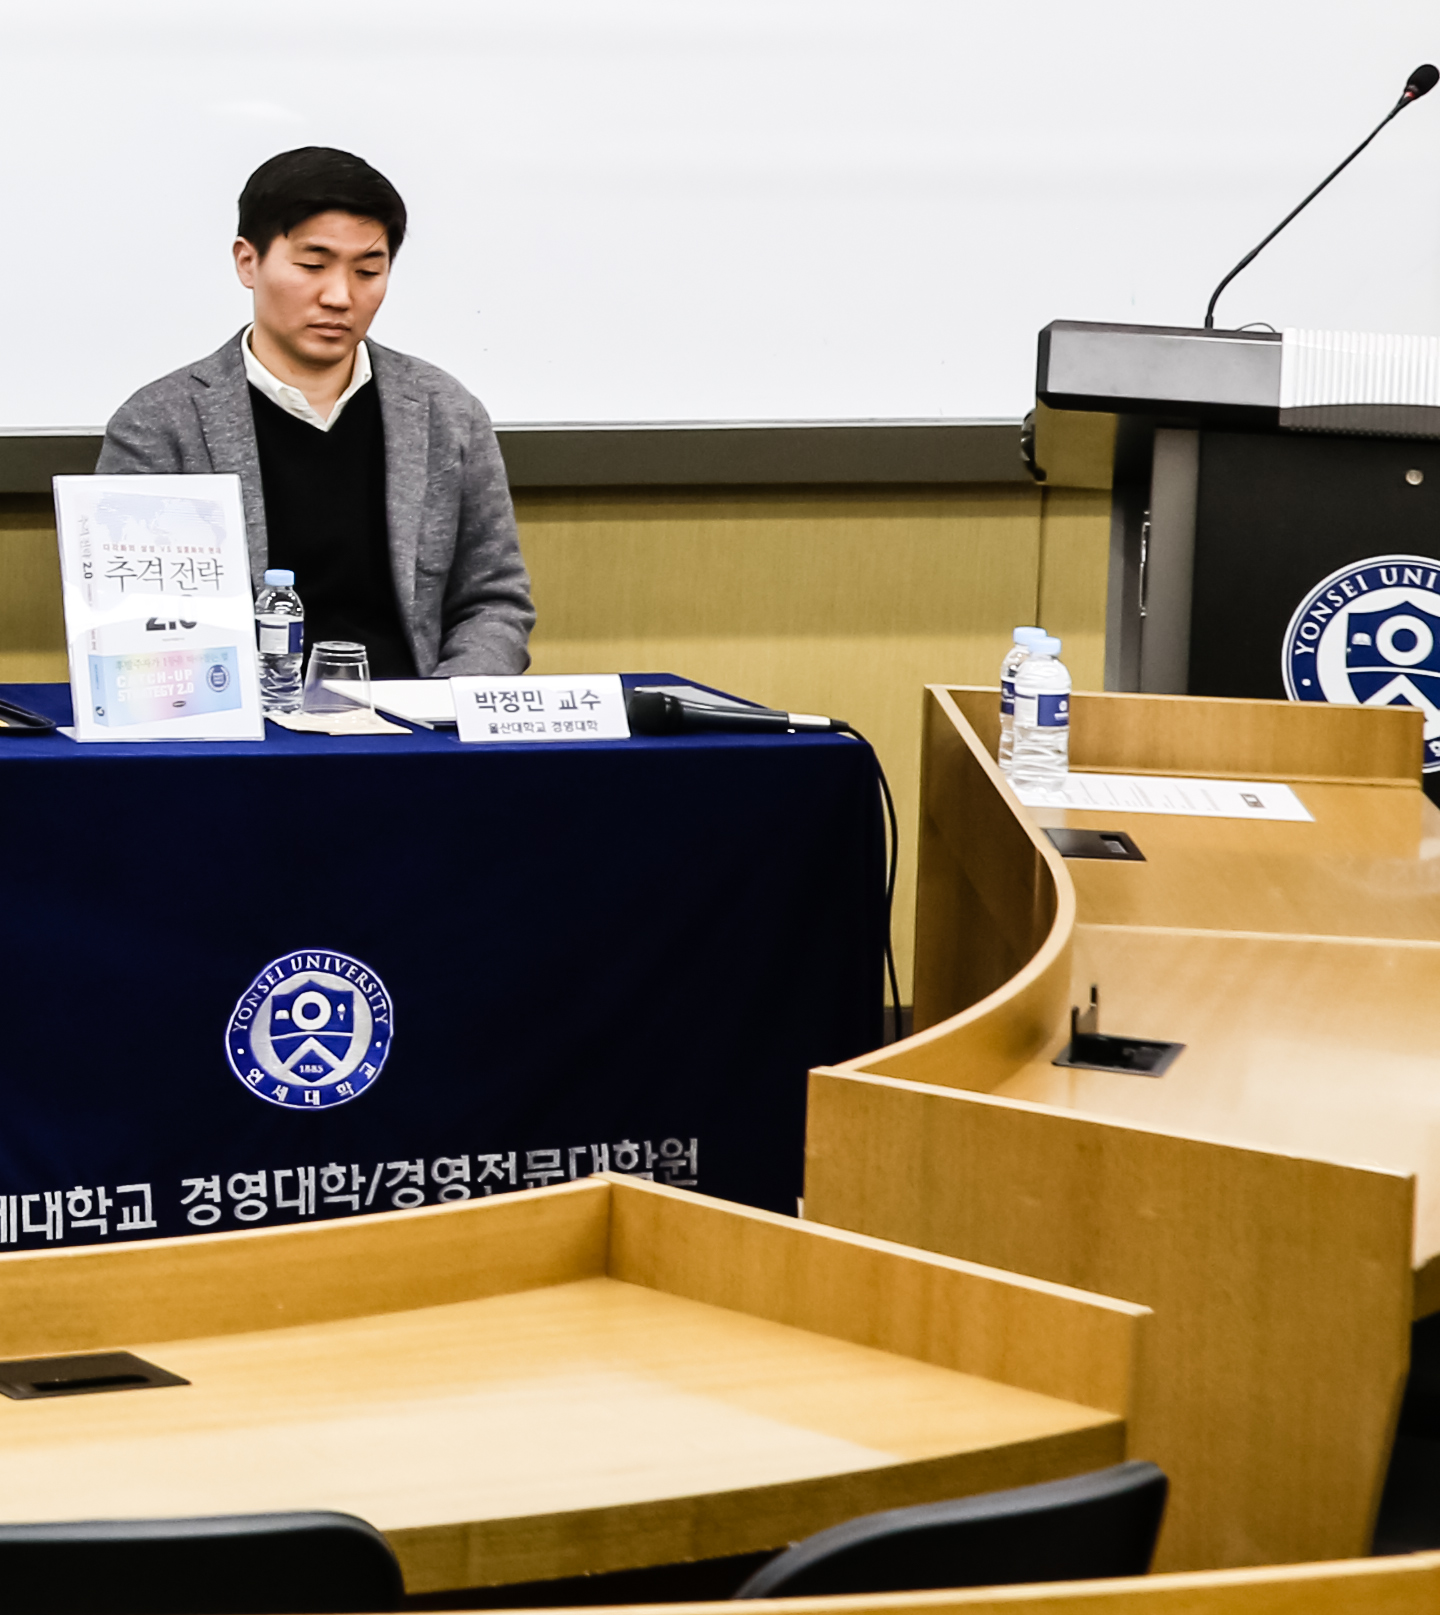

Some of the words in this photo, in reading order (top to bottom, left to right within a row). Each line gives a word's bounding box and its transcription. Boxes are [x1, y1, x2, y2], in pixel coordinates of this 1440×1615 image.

[104, 556, 163, 592] 추격
[170, 557, 224, 591] 전략
[1295, 574, 1369, 655] YONSEI
[1379, 567, 1437, 589] UNI
[474, 690, 544, 713] 박정민
[556, 690, 601, 711] 교수
[232, 966, 285, 1032] YONSEI
[291, 955, 388, 1024] UNIVERSITY
[246, 1062, 377, 1105] 연세대학교
